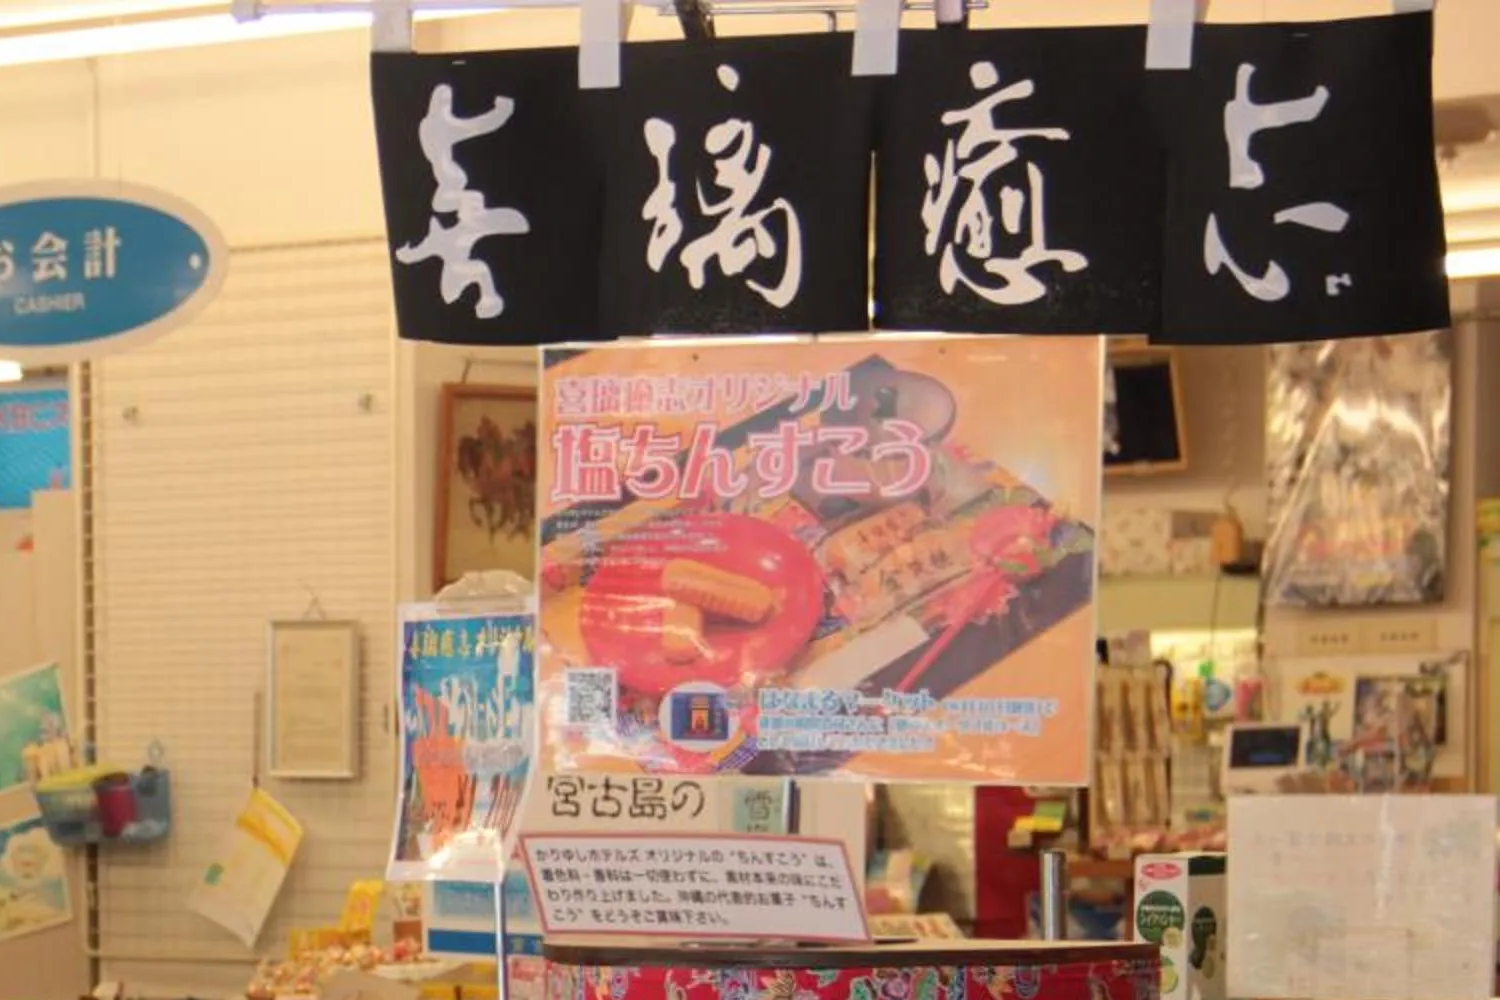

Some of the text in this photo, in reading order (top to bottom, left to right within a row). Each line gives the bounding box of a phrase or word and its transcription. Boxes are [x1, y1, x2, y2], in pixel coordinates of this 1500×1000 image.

[552, 419, 932, 500] 塩ちんすこう
[547, 775, 706, 820] 宮古島の
